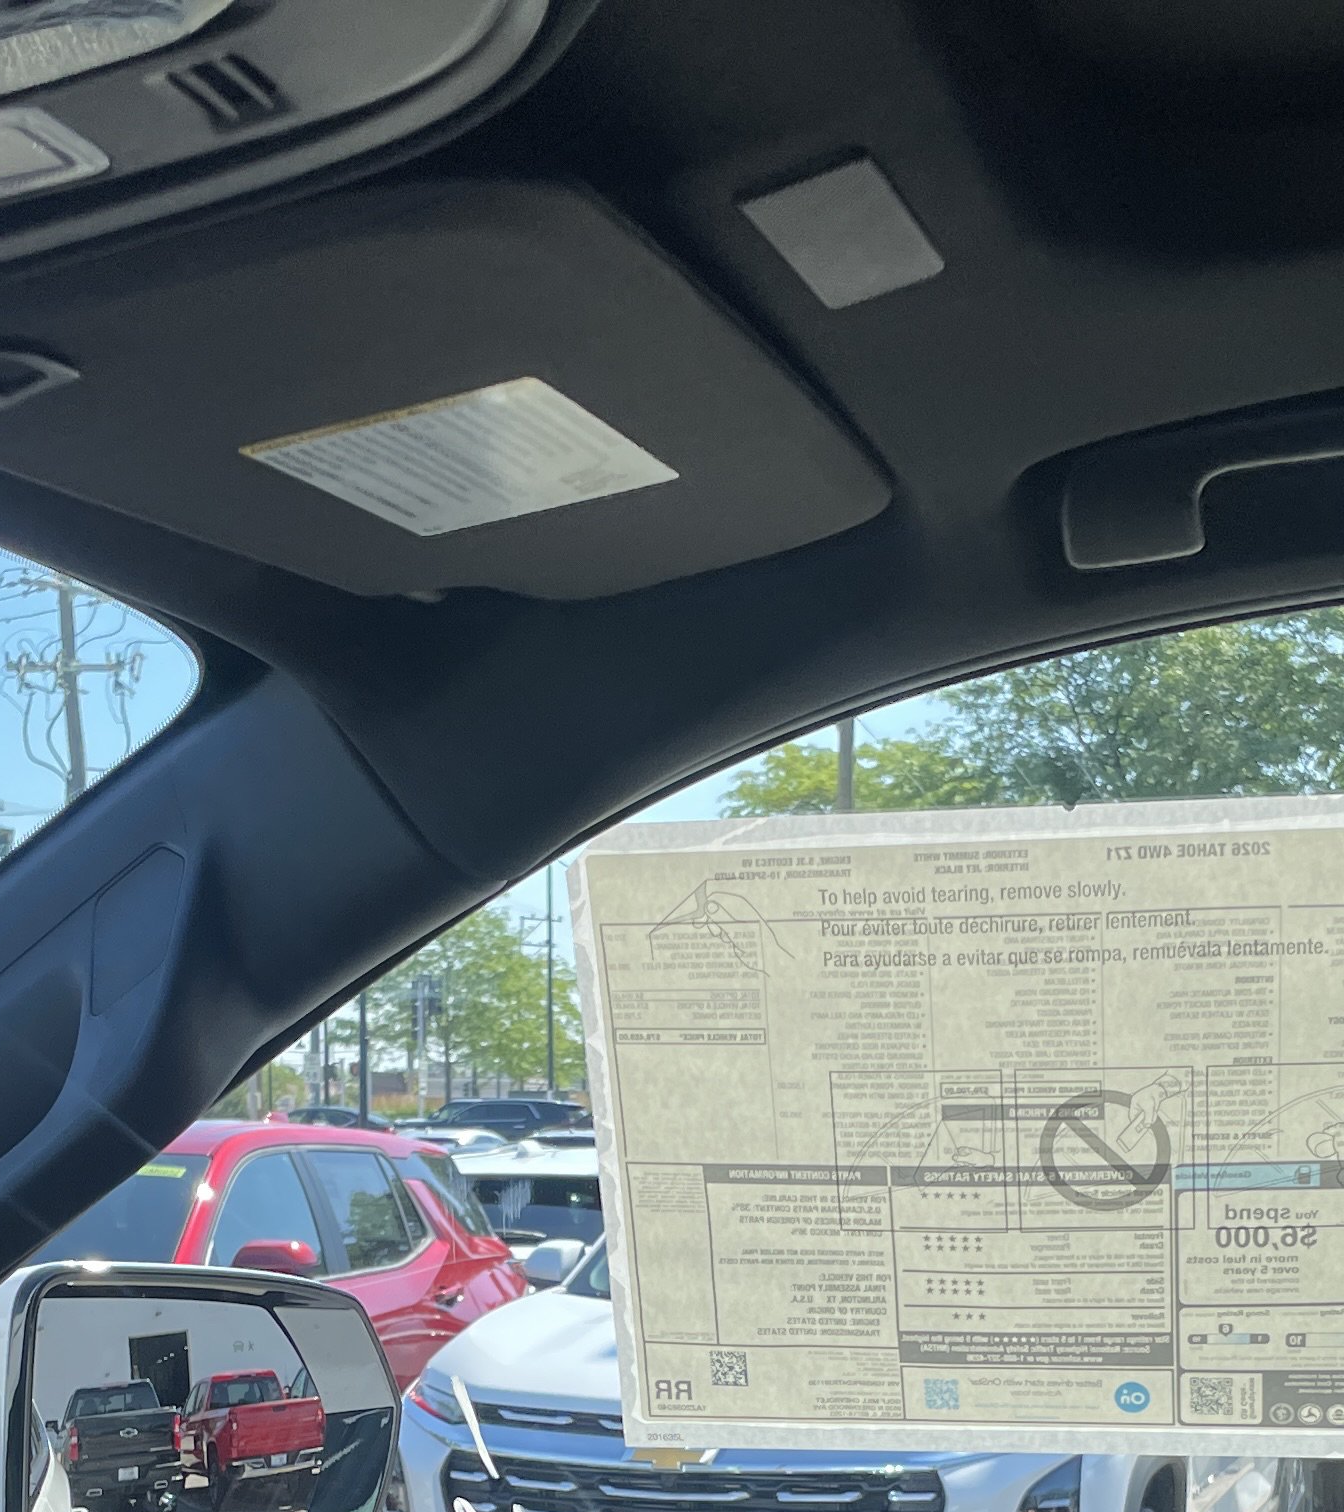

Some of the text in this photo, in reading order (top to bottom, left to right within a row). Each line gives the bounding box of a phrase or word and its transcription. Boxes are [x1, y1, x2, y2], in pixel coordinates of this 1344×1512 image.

[818, 880, 1126, 906] To help avoid tearing, remove slowly.
[821, 910, 1196, 936] Pour éviter toute déchirure, retirer lentement.
[823, 938, 1328, 970] Para ayudarse a evitar que se rompa, remuévala lentamente.
